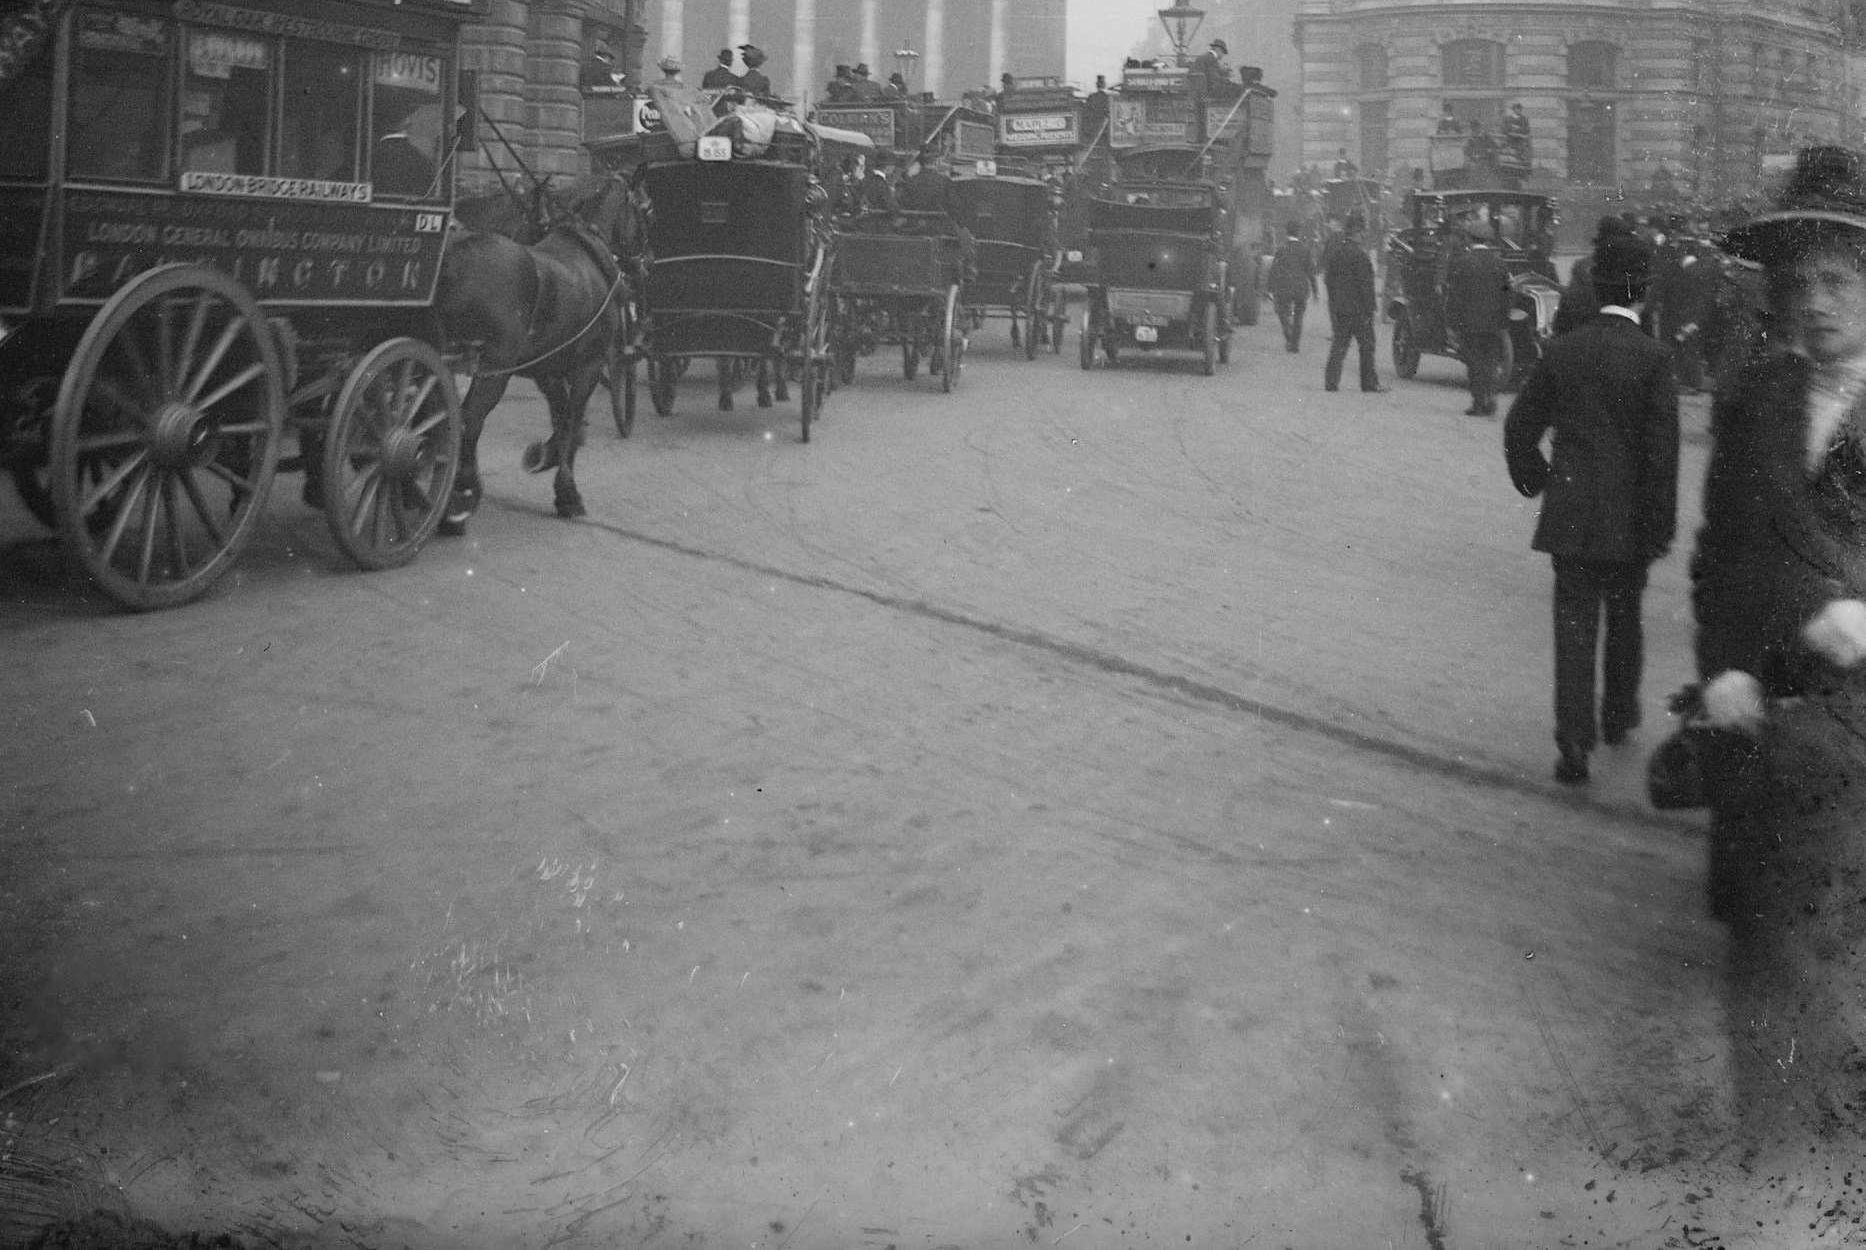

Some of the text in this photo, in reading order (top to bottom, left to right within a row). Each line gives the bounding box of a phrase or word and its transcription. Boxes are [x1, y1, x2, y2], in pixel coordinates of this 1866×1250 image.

[378, 52, 437, 84] HOVIS
[418, 214, 439, 230] DL
[88, 222, 422, 255] LONDON GENERAL OMNIBUS COMPANY LIMITED
